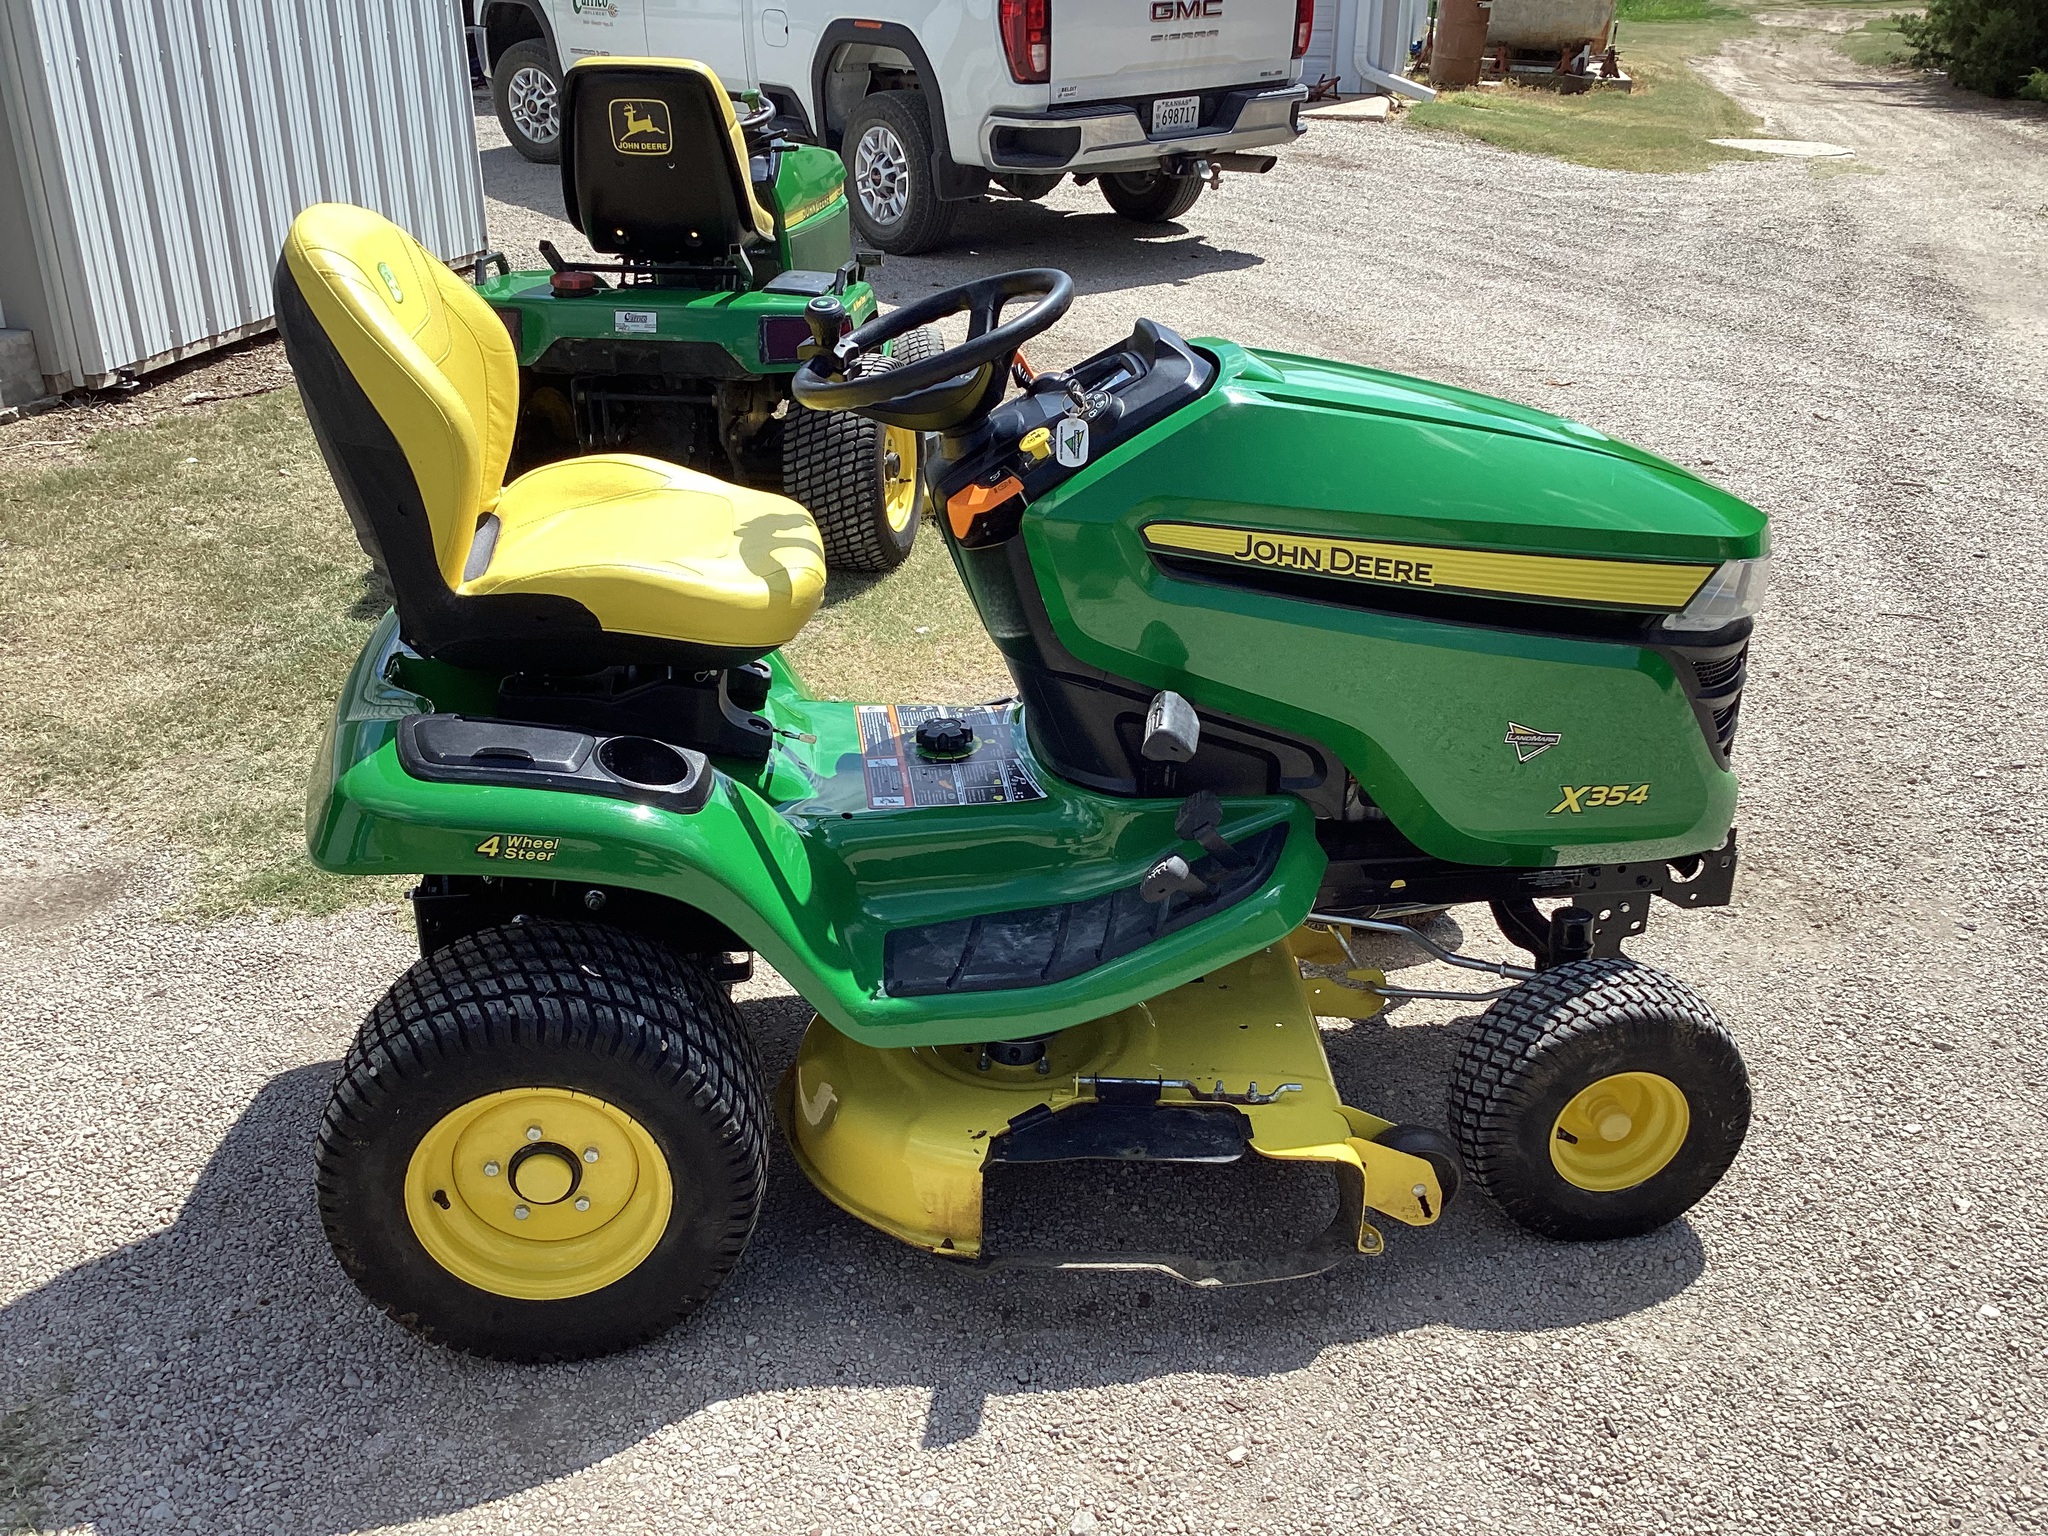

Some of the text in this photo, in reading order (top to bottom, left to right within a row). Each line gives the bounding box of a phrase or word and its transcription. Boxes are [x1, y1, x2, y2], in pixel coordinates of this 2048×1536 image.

[1150, 0, 1223, 21] GMC
[1151, 29, 1219, 41] SIERRA
[1161, 106, 1197, 126] 698717
[618, 141, 668, 151] JOHN DEERE
[1234, 534, 1434, 584] JOHN DEERE
[1548, 784, 1650, 814] X354
[477, 835, 559, 857] 4 Wheel
[503, 848, 556, 861] Steer
